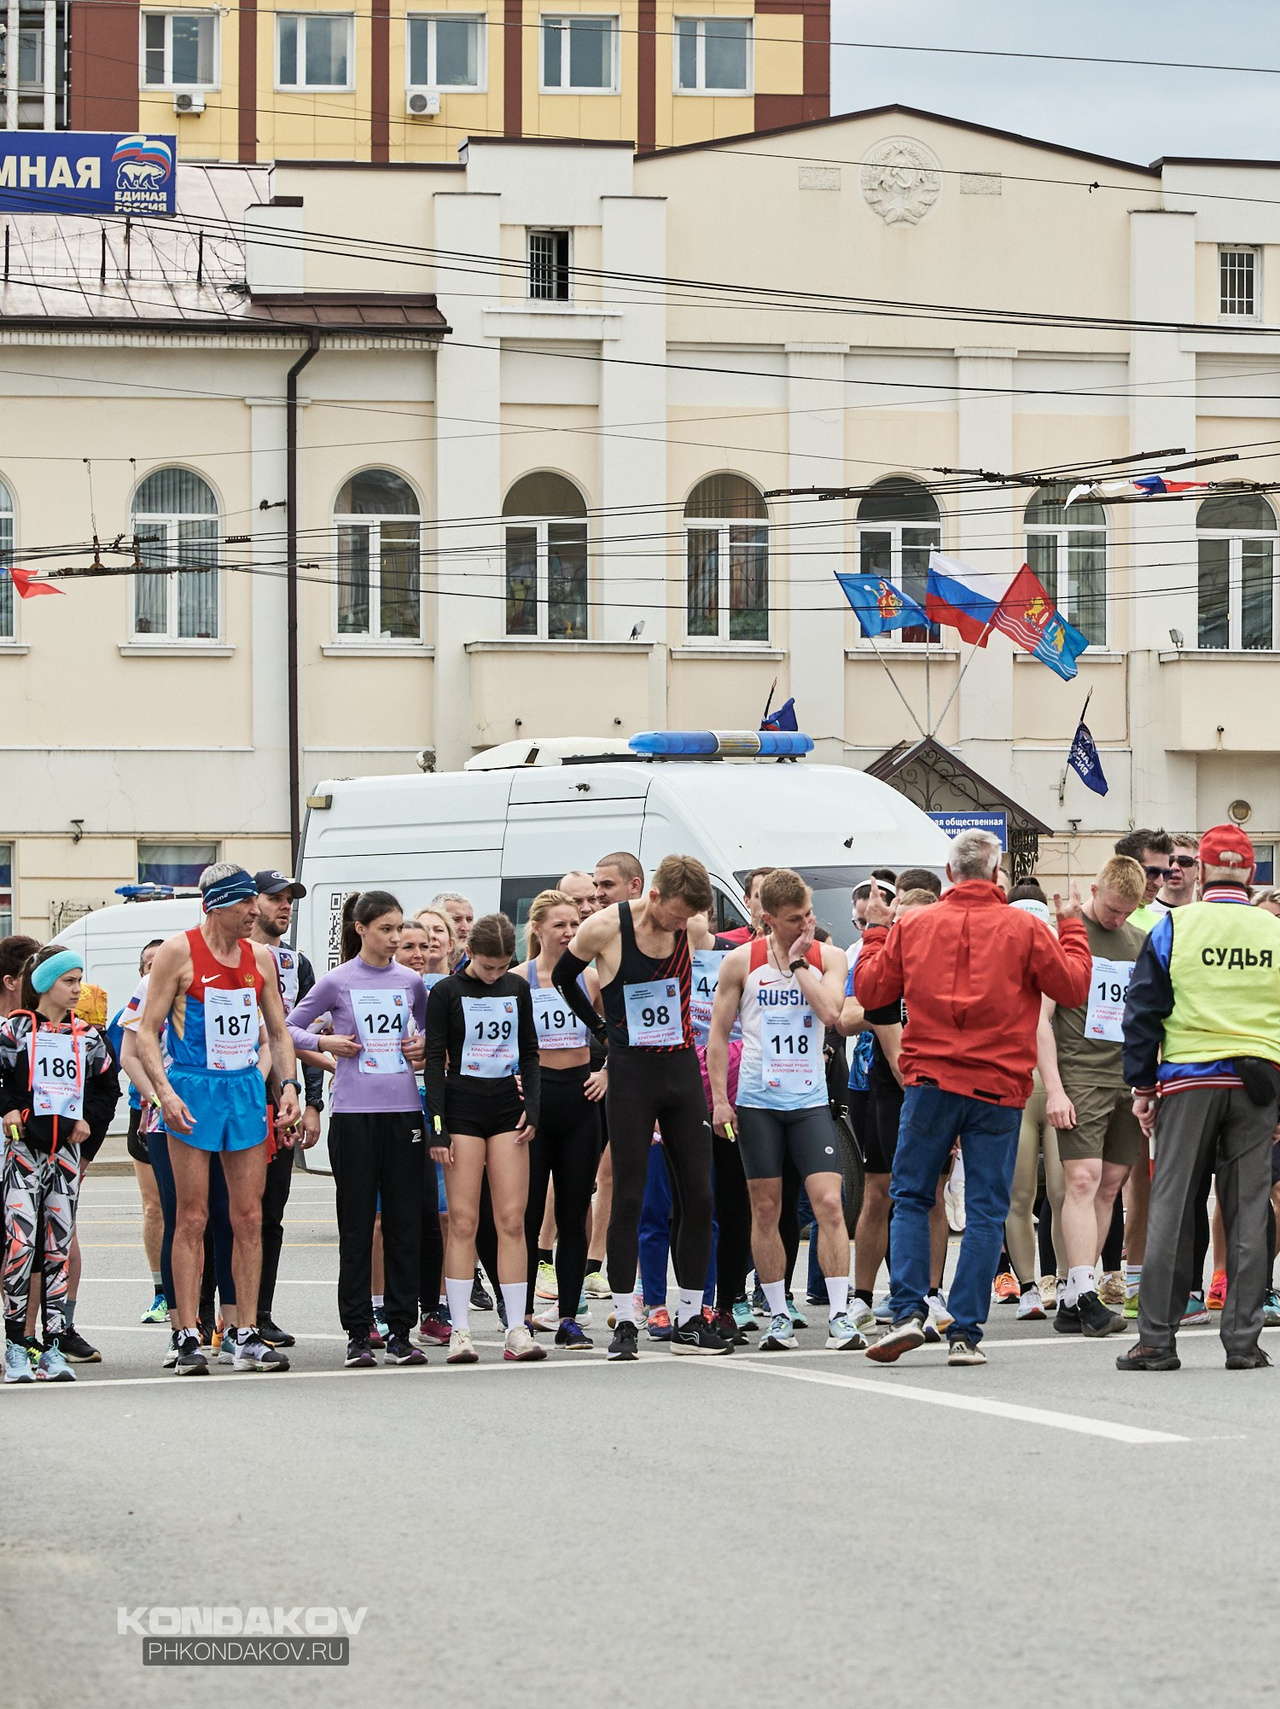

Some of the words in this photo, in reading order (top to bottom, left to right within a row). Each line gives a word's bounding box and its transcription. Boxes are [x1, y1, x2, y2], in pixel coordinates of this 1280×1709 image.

[114, 191, 167, 202] ЕДИНАЯ
[114, 202, 167, 213] РОССИЯ
[945, 817, 1004, 827] общественная
[1201, 947, 1273, 970] СУДЬЯ
[757, 989, 810, 1006] RUSSI
[1097, 981, 1129, 1004] 198
[540, 1009, 578, 1030] 191
[641, 1005, 670, 1028] 98
[689, 1006, 711, 1015] СНЫЙ
[692, 1014, 712, 1022] ОТОМ
[214, 1013, 251, 1036] 187
[364, 1013, 403, 1033] 124
[474, 1020, 512, 1040] 139
[771, 1034, 809, 1055] 118
[38, 1057, 77, 1080] 186
